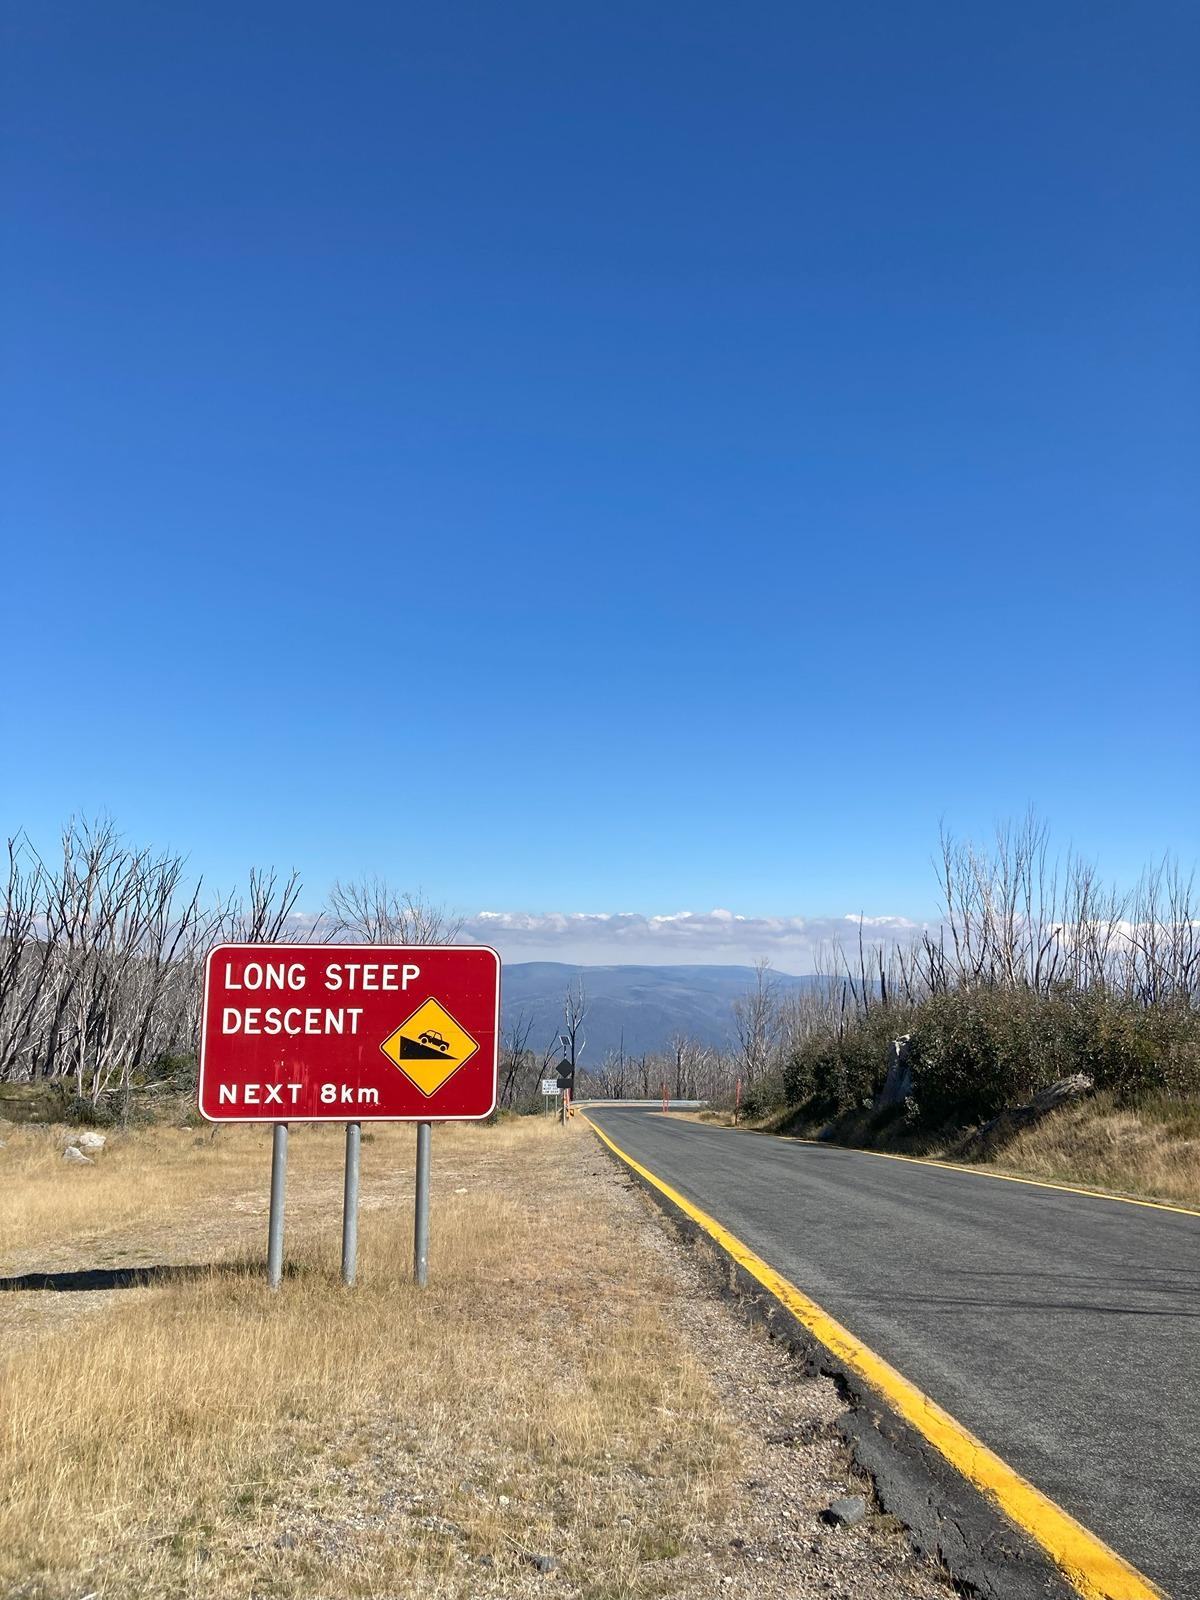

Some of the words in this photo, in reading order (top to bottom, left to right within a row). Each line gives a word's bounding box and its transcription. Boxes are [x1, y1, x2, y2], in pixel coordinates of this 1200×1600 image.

[224, 963, 306, 991] LONG
[324, 964, 421, 991] STEEP
[222, 1008, 364, 1035] DESCENT
[218, 1084, 303, 1105] NEXT
[320, 1083, 379, 1104] 8km
